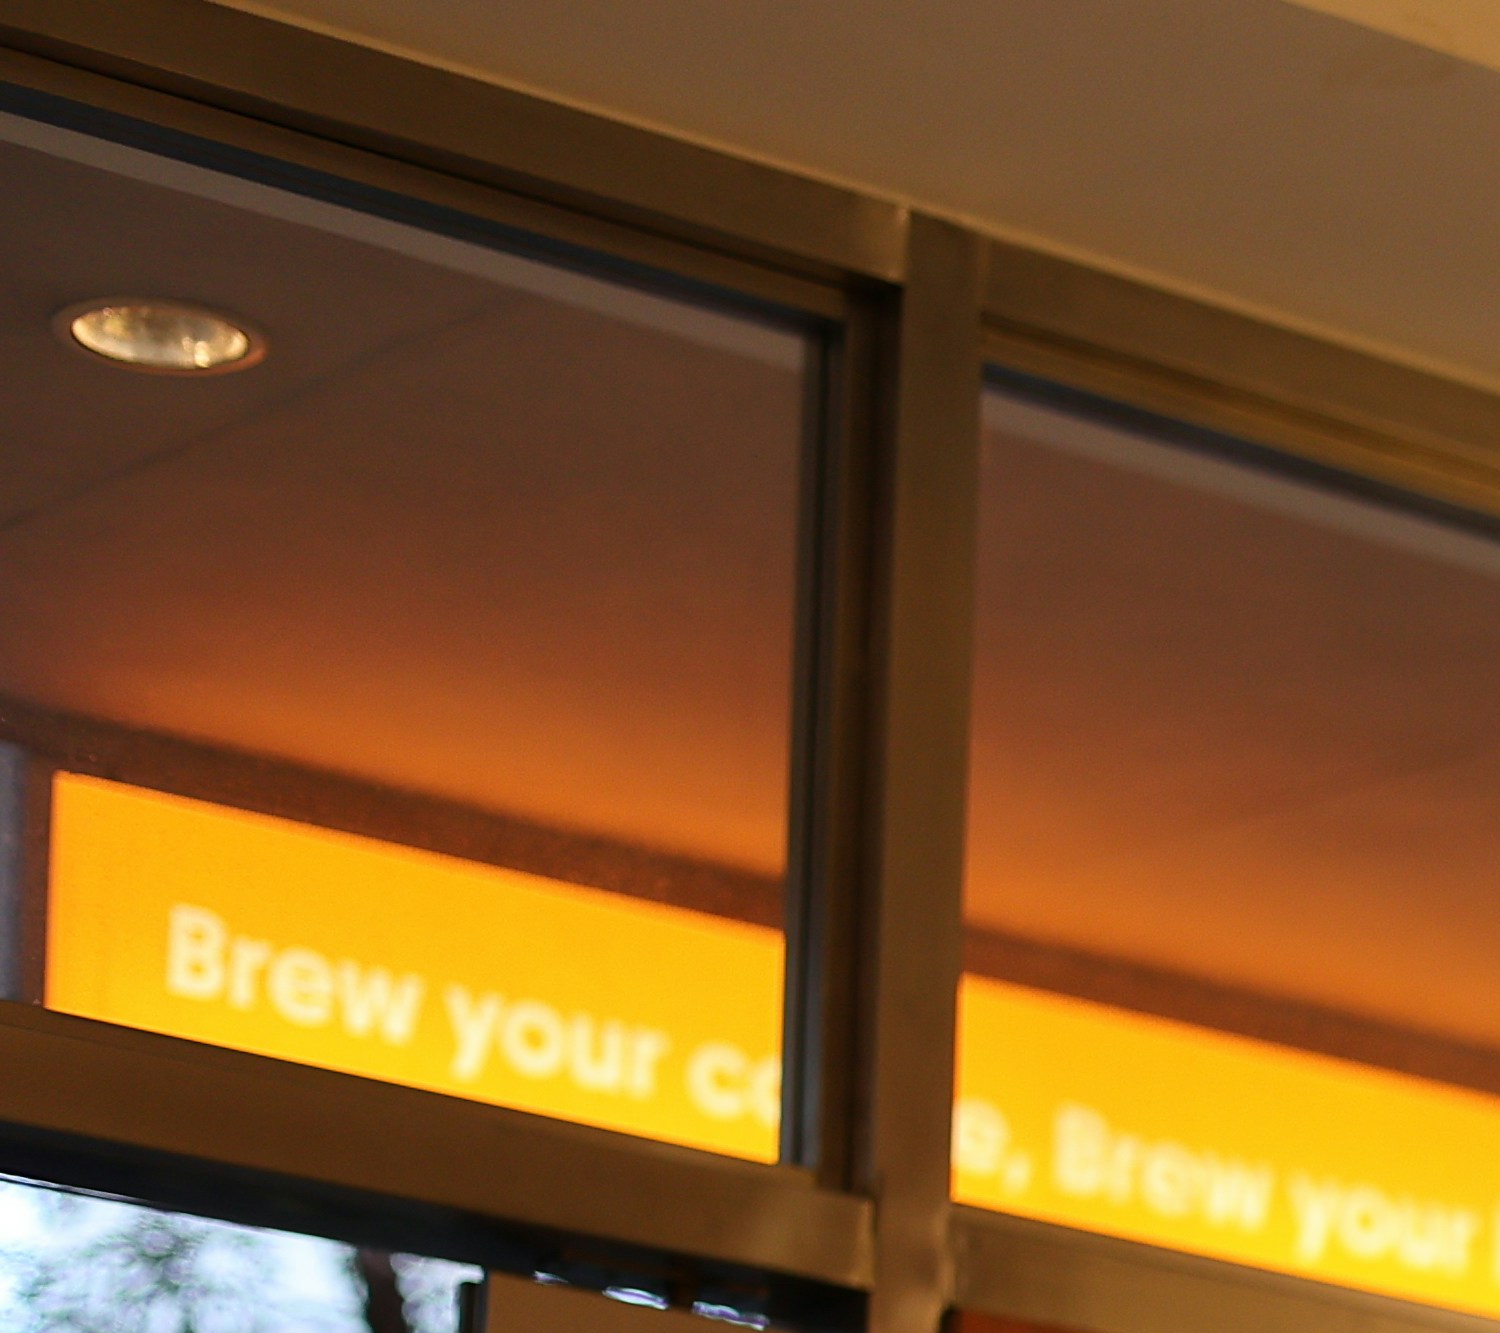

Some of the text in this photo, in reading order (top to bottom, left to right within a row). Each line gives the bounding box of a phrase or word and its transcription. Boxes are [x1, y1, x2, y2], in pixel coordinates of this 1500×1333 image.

[167, 902, 426, 1045] Brew
[442, 981, 672, 1083] your
[1056, 1103, 1274, 1232] Brew
[1288, 1168, 1476, 1265] your
